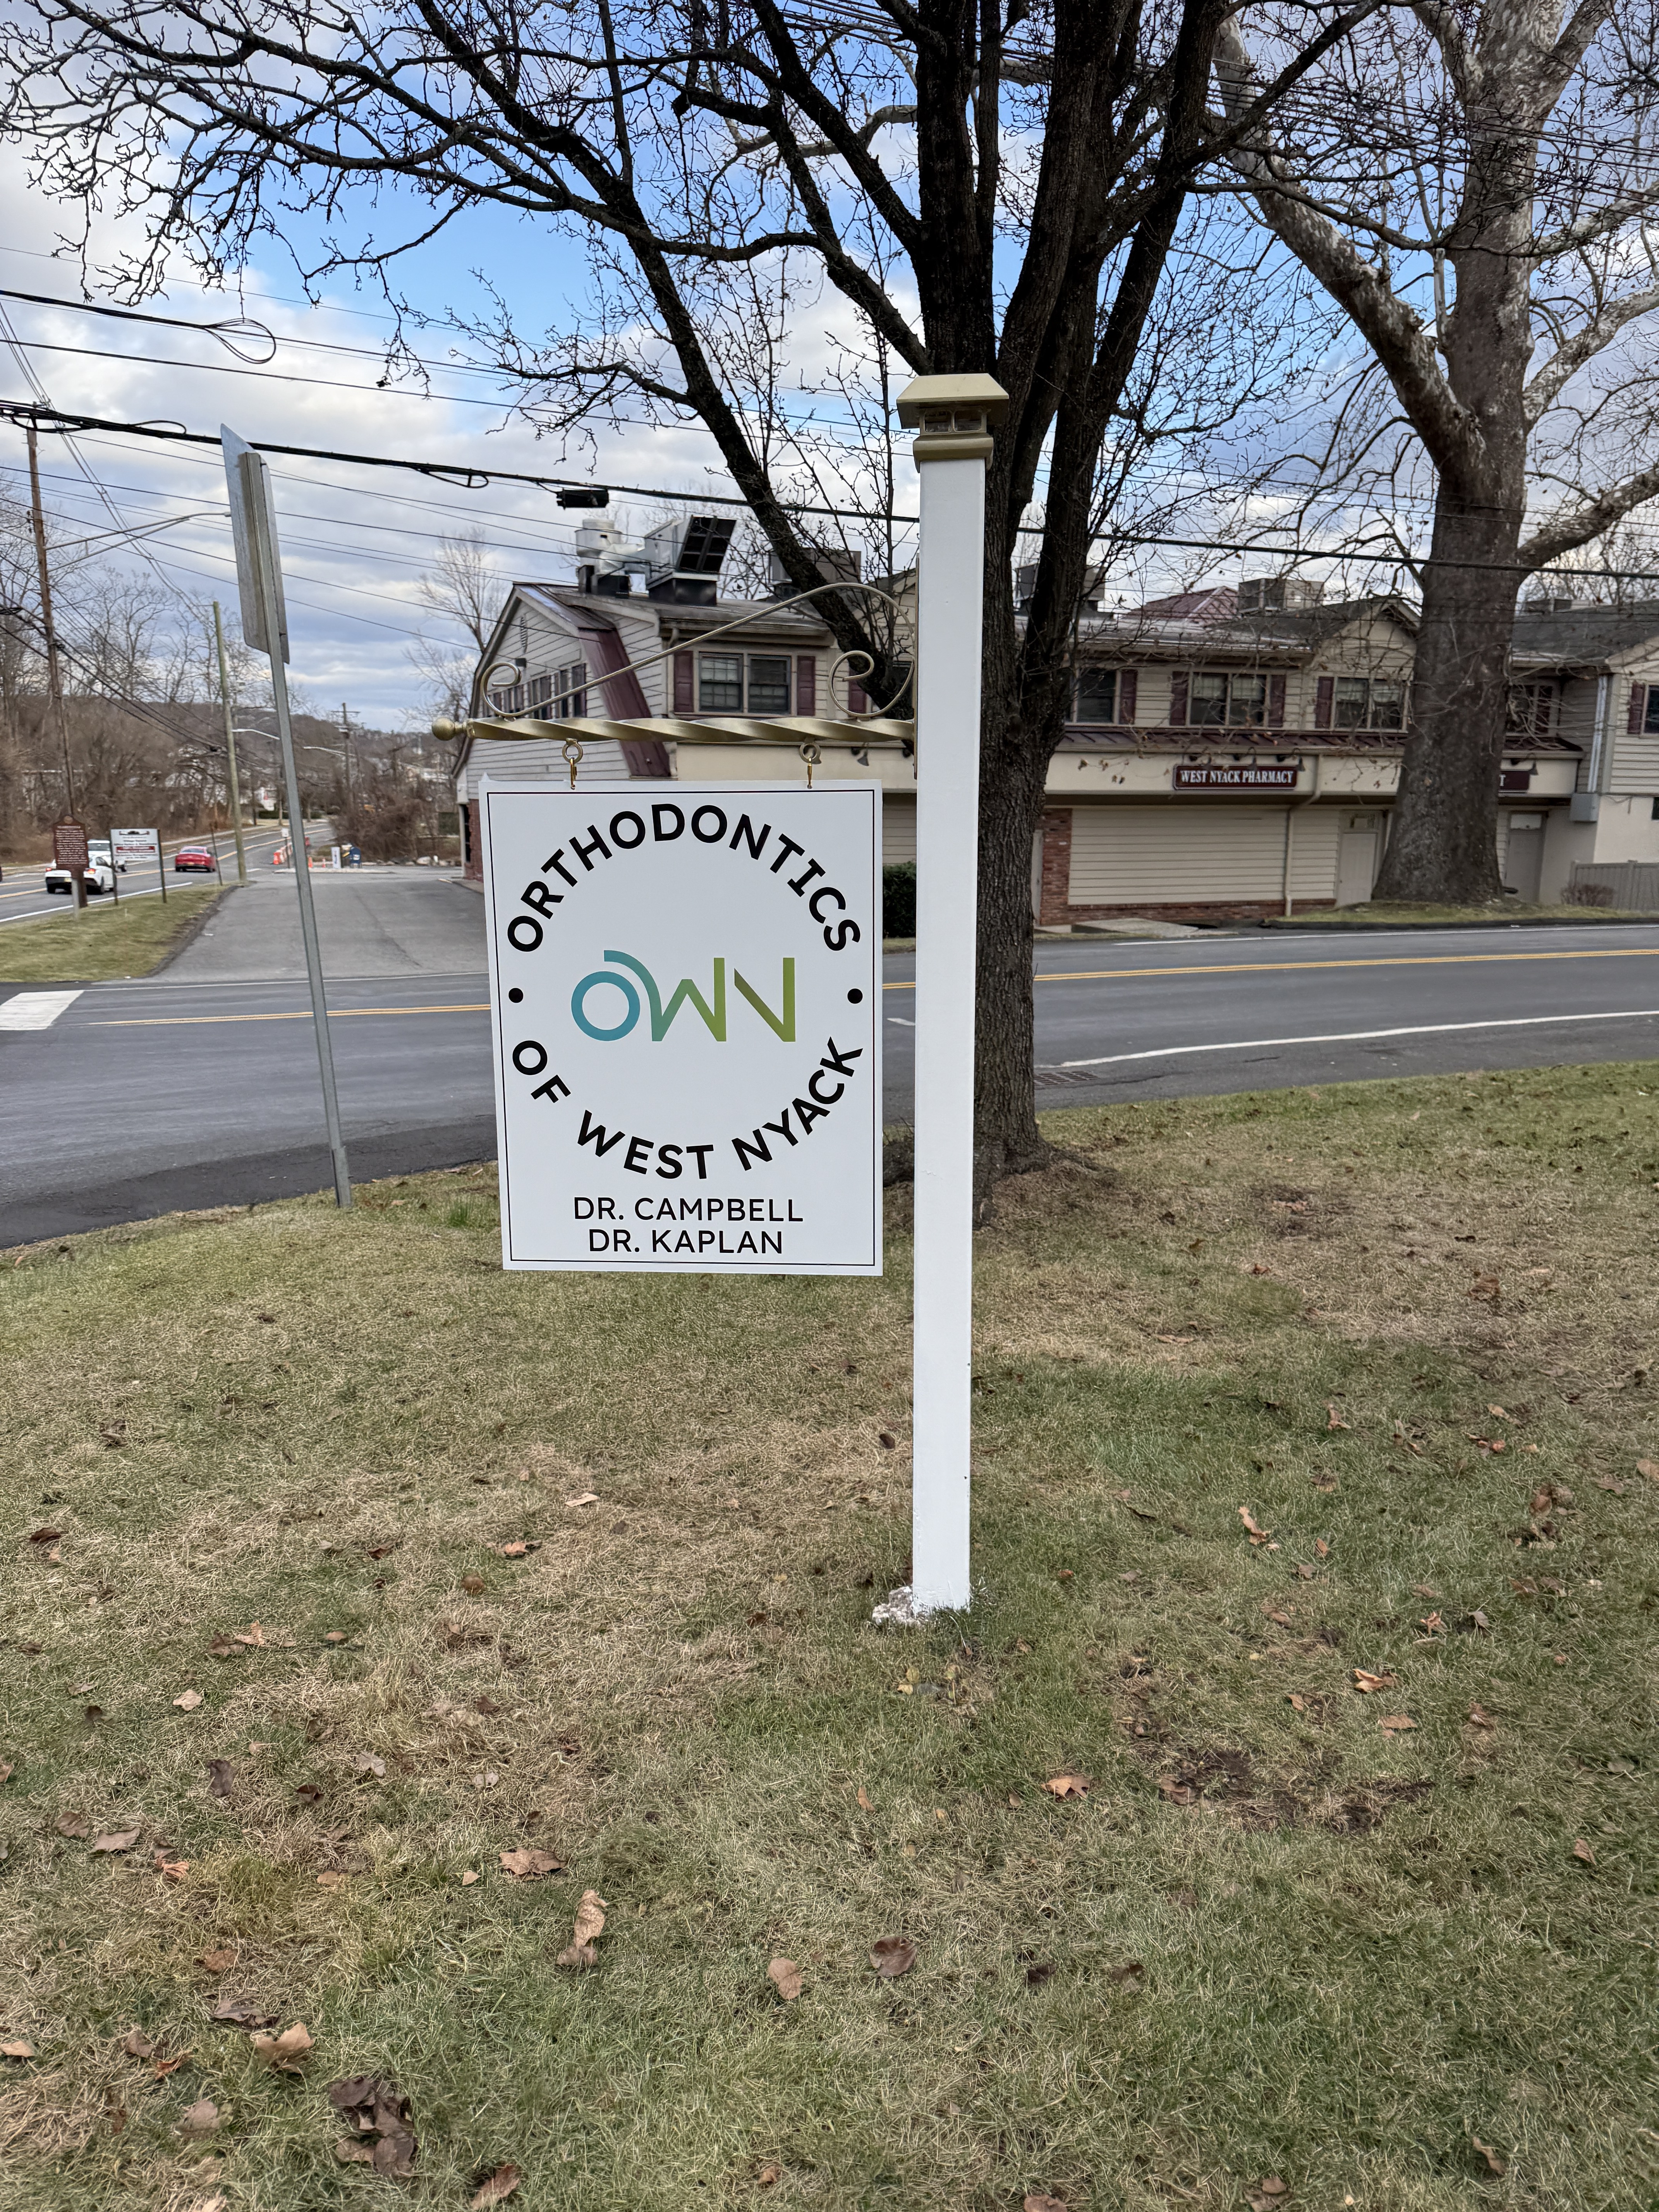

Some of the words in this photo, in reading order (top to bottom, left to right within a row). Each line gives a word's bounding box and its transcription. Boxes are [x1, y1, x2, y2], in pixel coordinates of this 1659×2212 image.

[1180, 770, 1207, 783] WEST
[1210, 770, 1241, 783] NYACK
[1242, 770, 1293, 783] PHARMACY
[508, 804, 860, 952] ORTHODONTICS
[571, 950, 795, 1042] OWN
[513, 1041, 571, 1103] OF
[578, 1110, 714, 1179] WEST
[732, 1037, 863, 1171] NYACK
[574, 1197, 623, 1220] DR.
[635, 1198, 803, 1221] CAMPBELL
[589, 1229, 639, 1252] DR.
[653, 1230, 781, 1254] KAPLAN
